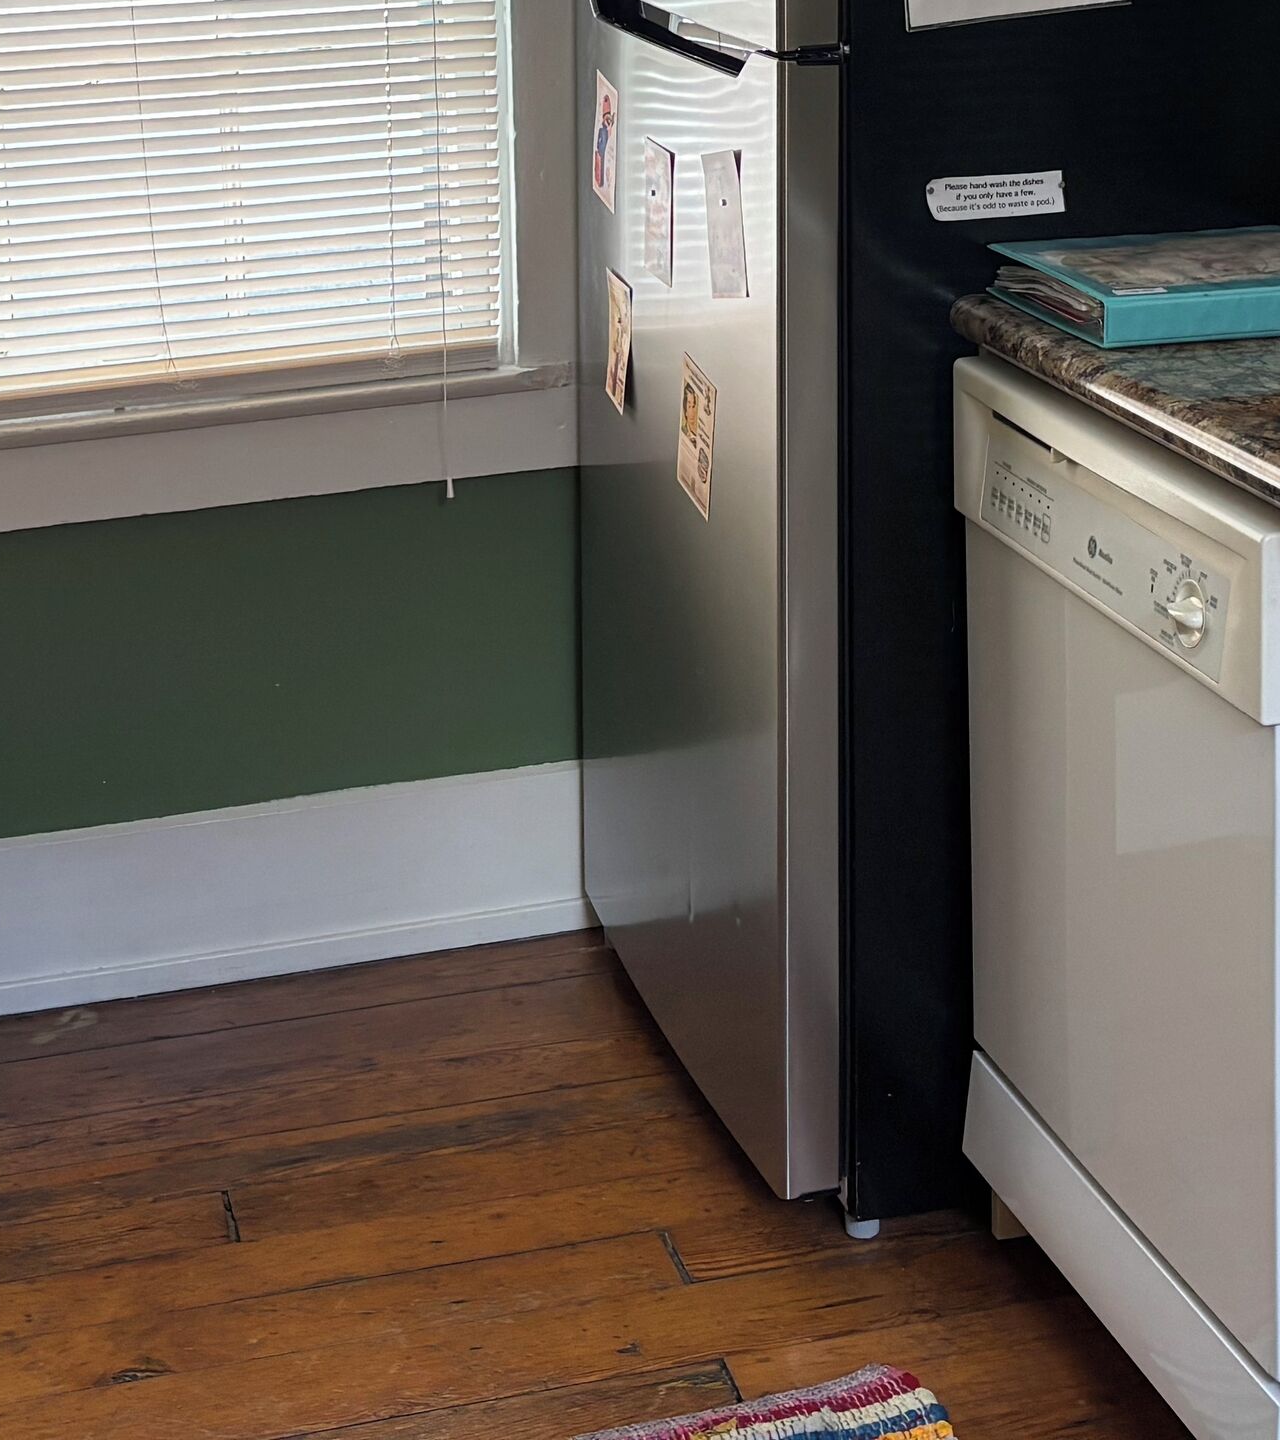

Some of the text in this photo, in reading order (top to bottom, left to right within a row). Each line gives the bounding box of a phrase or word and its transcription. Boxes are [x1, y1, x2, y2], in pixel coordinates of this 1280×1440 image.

[945, 183, 967, 191] Please
[989, 180, 1007, 188] wash
[1022, 177, 1044, 185] dishes
[963, 193, 977, 201] you
[978, 192, 994, 200] only
[936, 204, 967, 213] (Because
